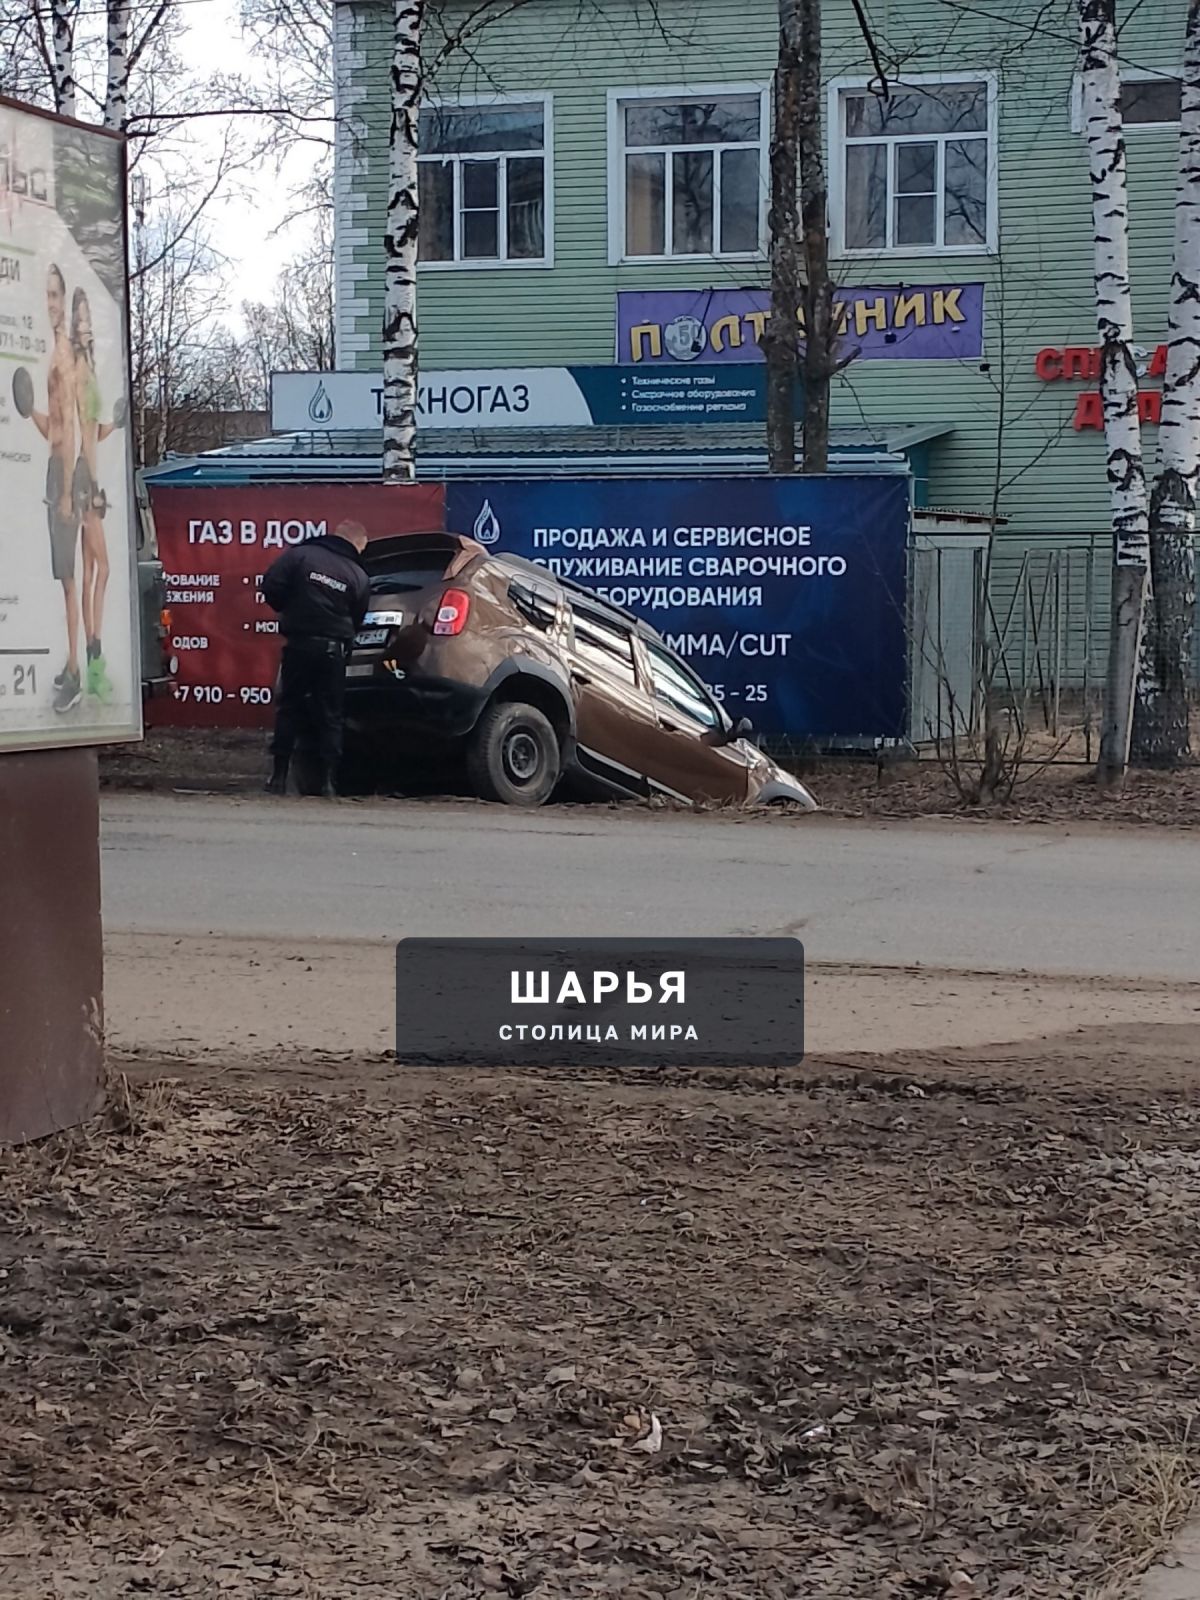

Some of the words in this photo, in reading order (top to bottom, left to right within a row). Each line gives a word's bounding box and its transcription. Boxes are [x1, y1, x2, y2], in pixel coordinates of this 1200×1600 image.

[188, 520, 233, 545] ГАЗ
[240, 521, 256, 544] В
[533, 527, 646, 550] ПРОДАЖА
[652, 528, 667, 548] И
[673, 526, 812, 547] СЕРВИСНОЕ
[688, 556, 848, 577] СВАРОЧНОГО
[13, 664, 37, 695] 21
[173, 685, 190, 702] +7
[193, 685, 223, 703] 910
[240, 686, 272, 704] 950
[745, 684, 768, 702] 25
